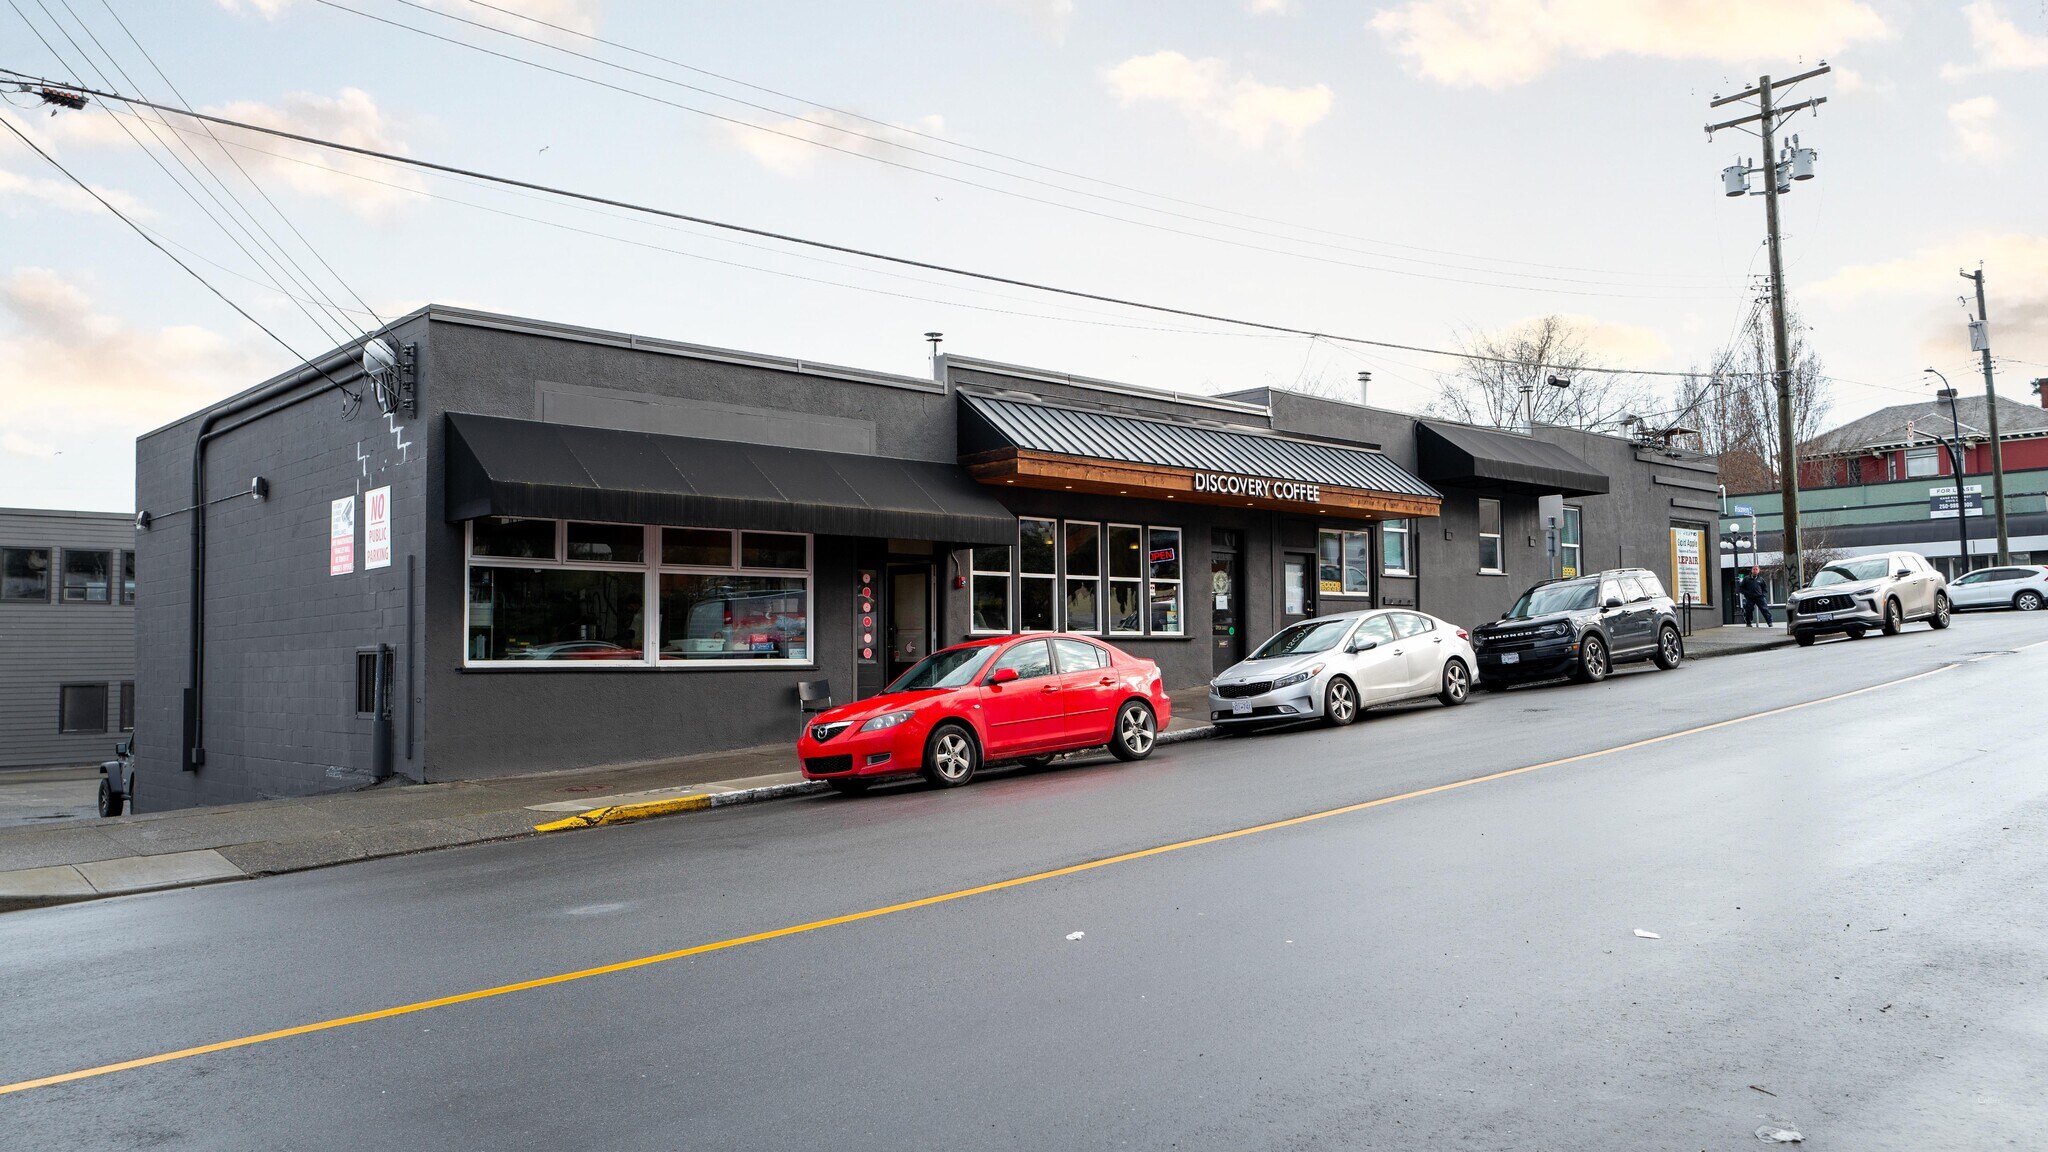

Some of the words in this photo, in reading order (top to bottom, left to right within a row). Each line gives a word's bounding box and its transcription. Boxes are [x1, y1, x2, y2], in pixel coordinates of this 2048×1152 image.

[1195, 472, 1270, 497] DISCOVERY
[1273, 481, 1320, 502] COFFEE
[371, 493, 385, 521] NO
[369, 527, 387, 544] PUBLIC
[367, 547, 389, 564] PARKING
[1488, 631, 1532, 640] BRONCO
